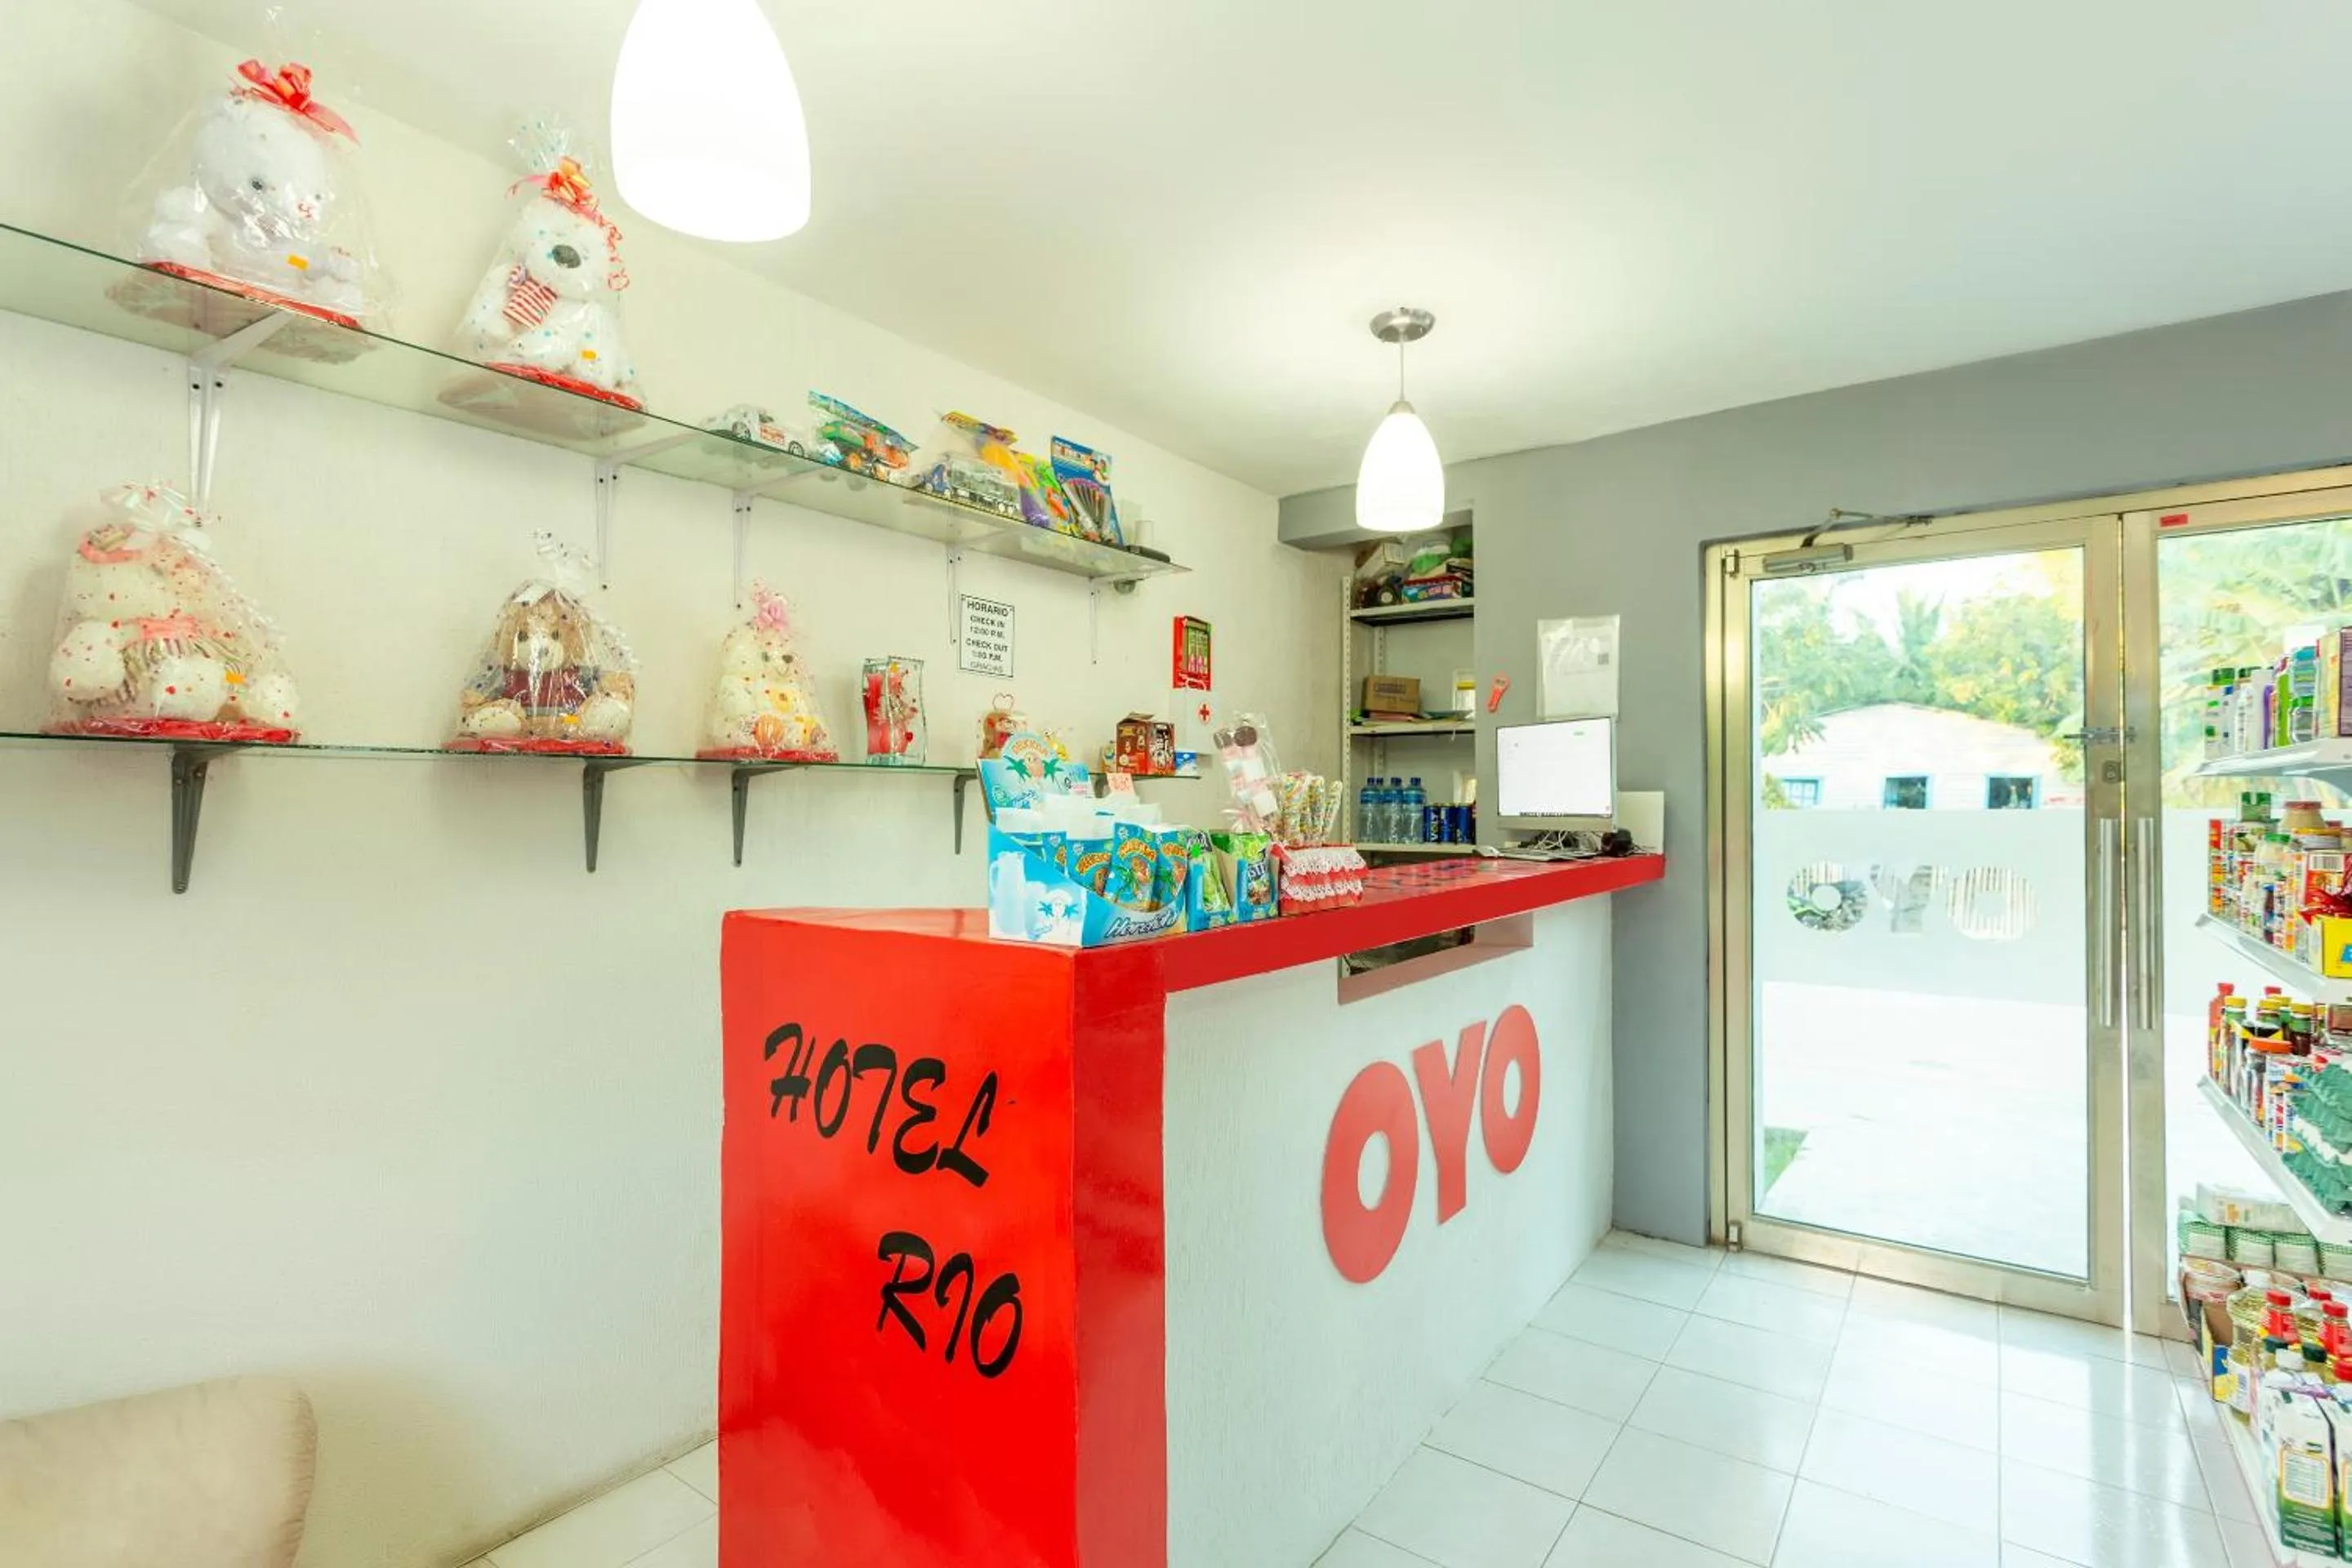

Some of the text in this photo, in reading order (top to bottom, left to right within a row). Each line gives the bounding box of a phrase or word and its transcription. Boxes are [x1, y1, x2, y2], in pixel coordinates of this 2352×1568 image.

[965, 638, 1009, 653] CHECK OUT
[967, 601, 1008, 617] HORARIO
[969, 614, 996, 626] CHECK
[1786, 860, 2039, 942] OYO
[764, 1022, 998, 1188] HOTEL
[1320, 1004, 1541, 1285] OYO
[876, 1230, 1024, 1379] RIO
